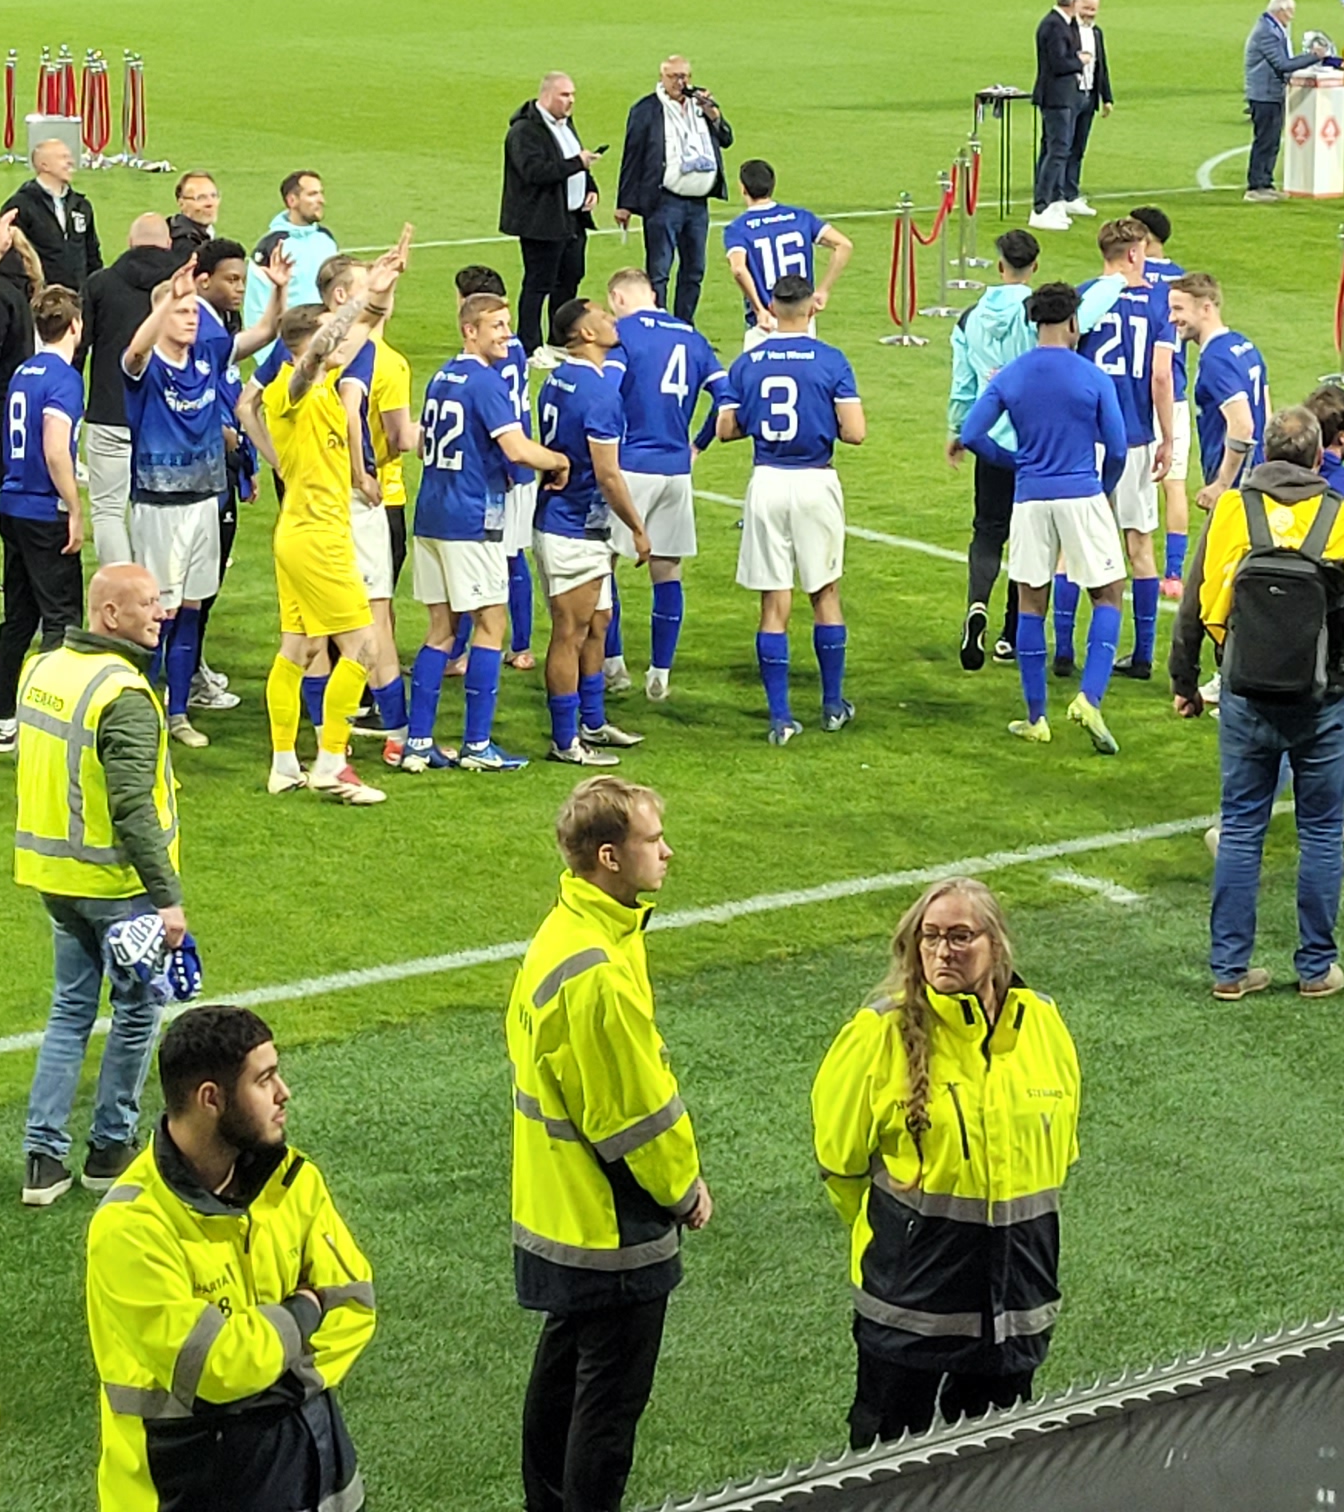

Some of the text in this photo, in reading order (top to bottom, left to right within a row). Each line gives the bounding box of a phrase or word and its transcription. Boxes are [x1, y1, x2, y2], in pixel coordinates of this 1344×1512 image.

[753, 231, 807, 290] 16
[660, 343, 689, 408] 4
[1093, 312, 1148, 379] 21
[9, 390, 27, 460] 8
[423, 398, 465, 471] 32
[760, 375, 799, 442] 3
